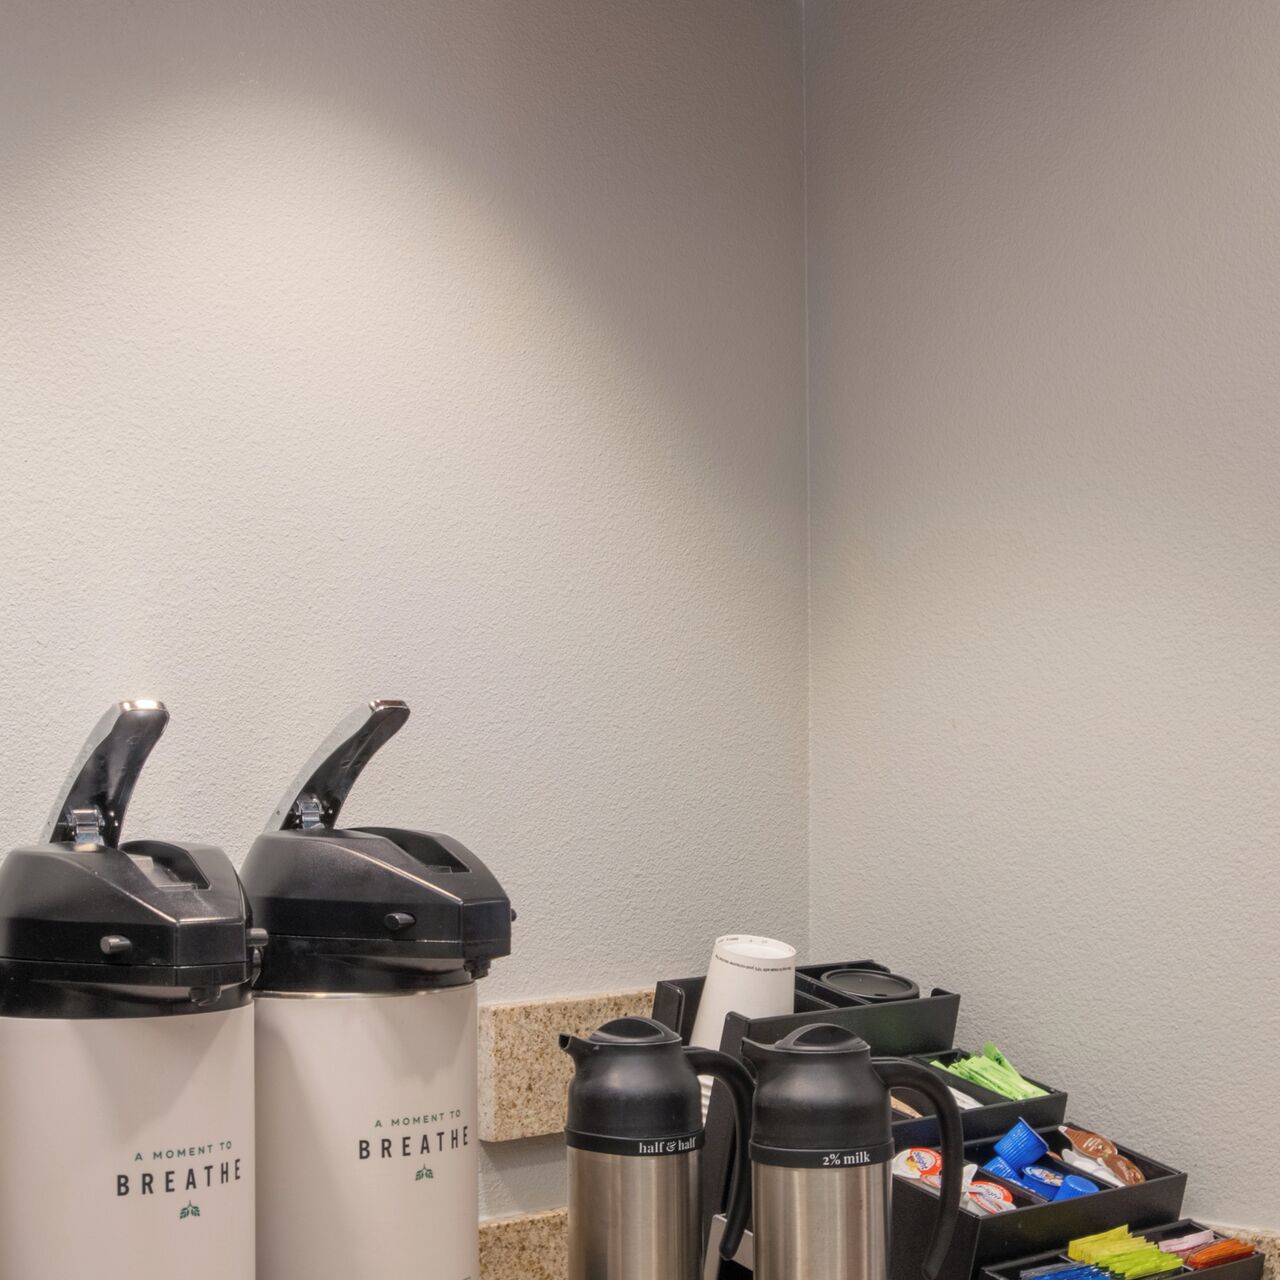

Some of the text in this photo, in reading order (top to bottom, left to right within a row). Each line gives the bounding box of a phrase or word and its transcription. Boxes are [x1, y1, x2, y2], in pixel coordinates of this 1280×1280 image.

[375, 1109, 461, 1128] A MOMENT TO
[134, 1140, 232, 1161] A MOMENT TO
[358, 1125, 469, 1160] BREATHE
[638, 1137, 696, 1154] half & half
[822, 1151, 871, 1166] 2% milk
[116, 1158, 241, 1197] BREATHE
